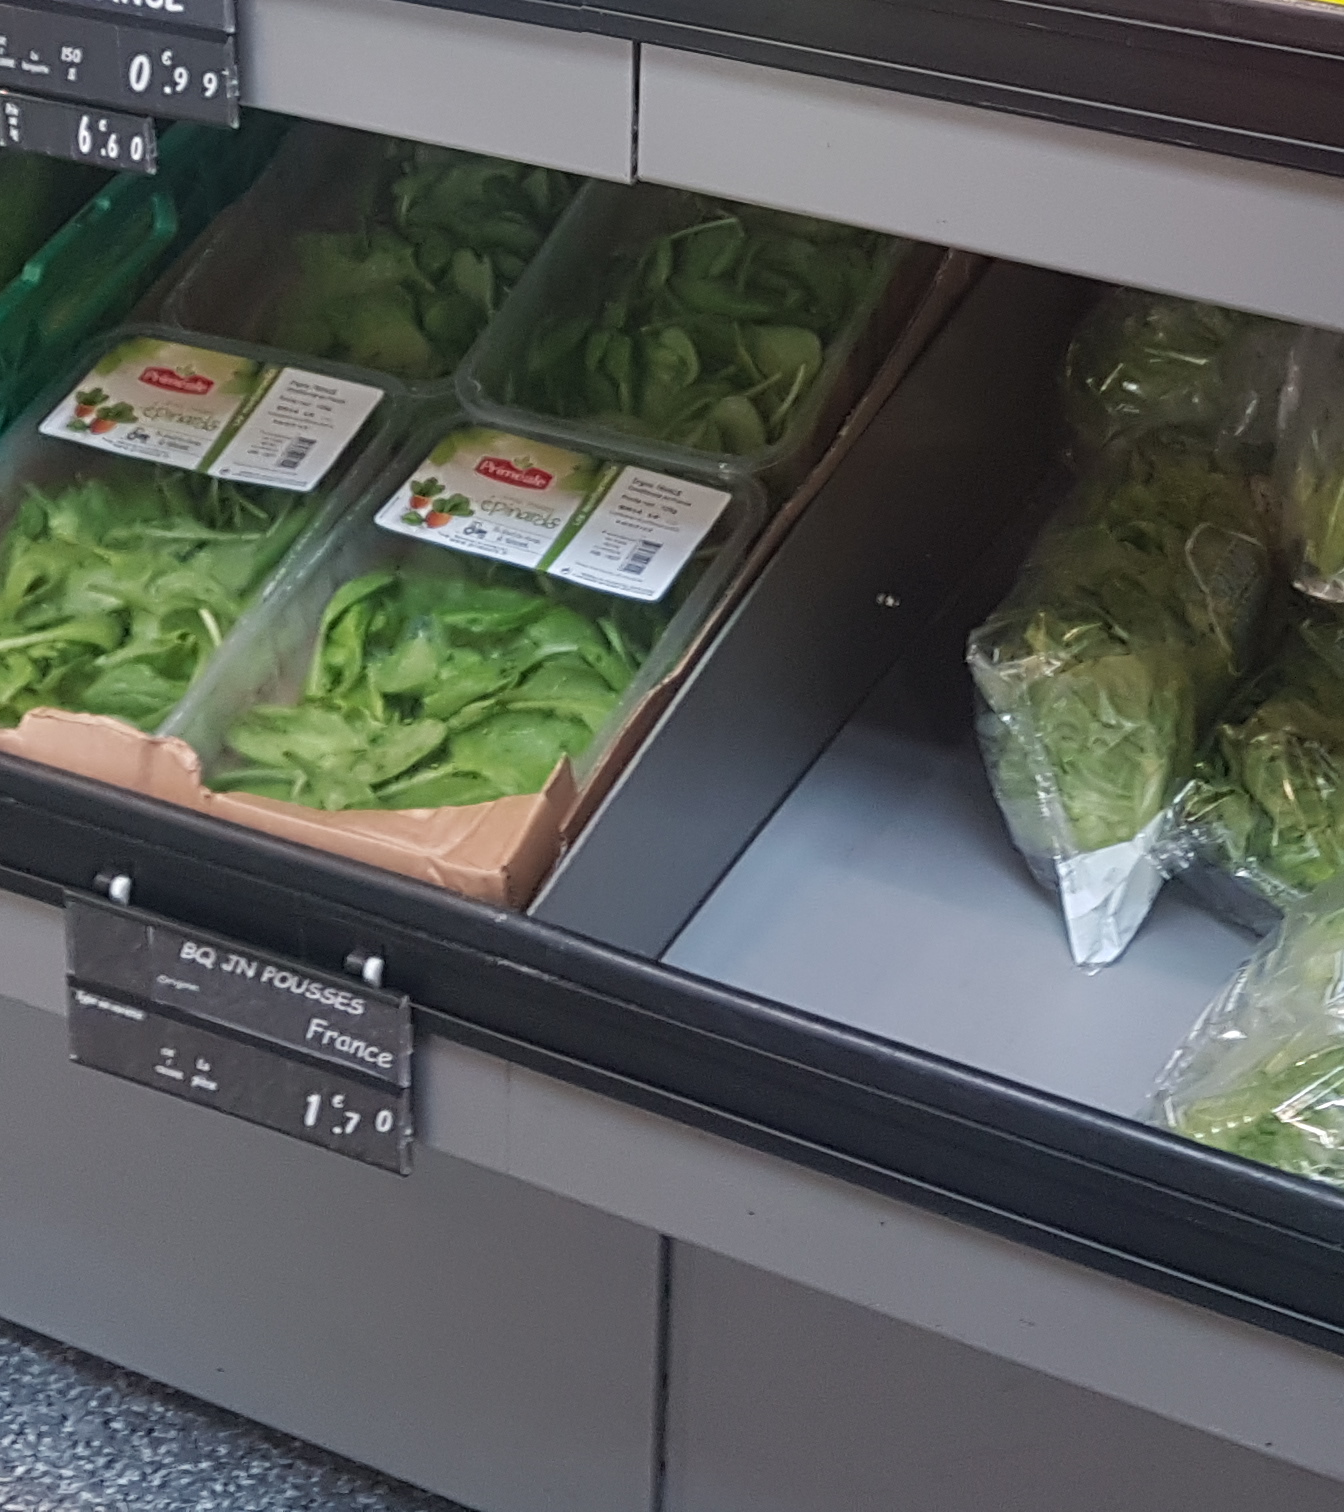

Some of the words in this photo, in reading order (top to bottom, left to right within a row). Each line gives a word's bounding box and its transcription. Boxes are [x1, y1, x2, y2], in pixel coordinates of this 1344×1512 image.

[179, 940, 217, 969] BQ
[219, 954, 256, 979] JN
[260, 964, 366, 1017] POUSSES
[304, 1017, 394, 1069] France
